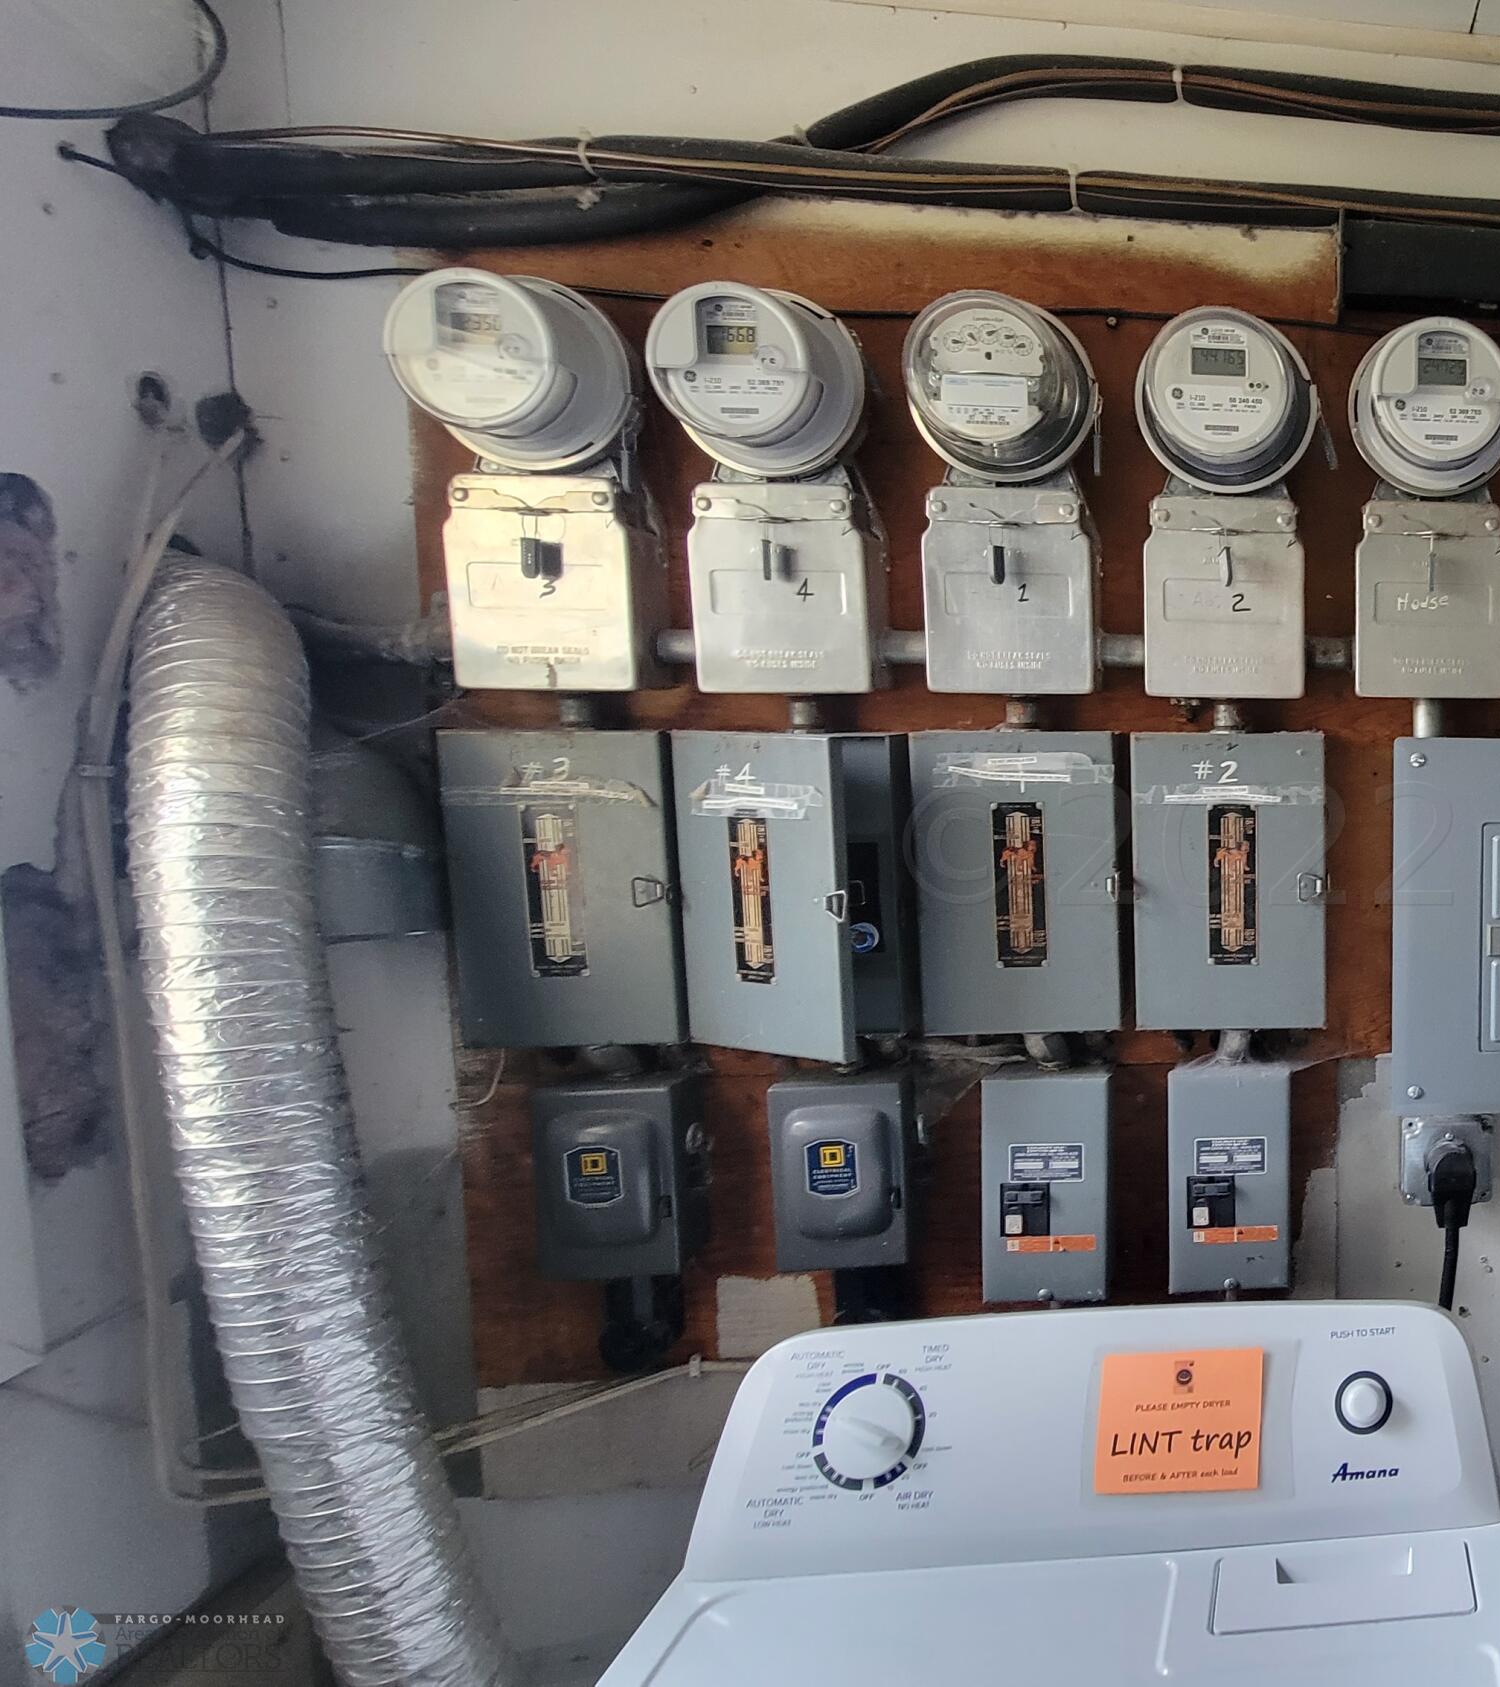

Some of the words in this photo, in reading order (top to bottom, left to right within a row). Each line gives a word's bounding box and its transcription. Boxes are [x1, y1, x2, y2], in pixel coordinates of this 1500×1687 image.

[796, 578, 815, 602] 4
[1017, 583, 1030, 602] 1
[1232, 593, 1252, 612] 2
[715, 763, 757, 787] #4
[1191, 760, 1239, 784] #2
[1330, 1330, 1354, 1339] PUSH
[1356, 1328, 1367, 1337] TO
[1369, 1326, 1396, 1336] START
[1135, 1403, 1167, 1412] PLEASE
[1171, 1401, 1201, 1410] EMPTY
[1203, 1399, 1231, 1408] DRYER
[1111, 1430, 1183, 1457] LINT
[1191, 1429, 1252, 1459] trap
[1123, 1472, 1156, 1482] BEFORE
[1169, 1471, 1198, 1480] AFTER
[1200, 1468, 1219, 1477] each
[1222, 1467, 1239, 1476] load
[1331, 1462, 1400, 1483] Amana
[745, 1496, 804, 1508] AUTOMATIC
[896, 1491, 912, 1501] AIR
[913, 1490, 934, 1499] DRY
